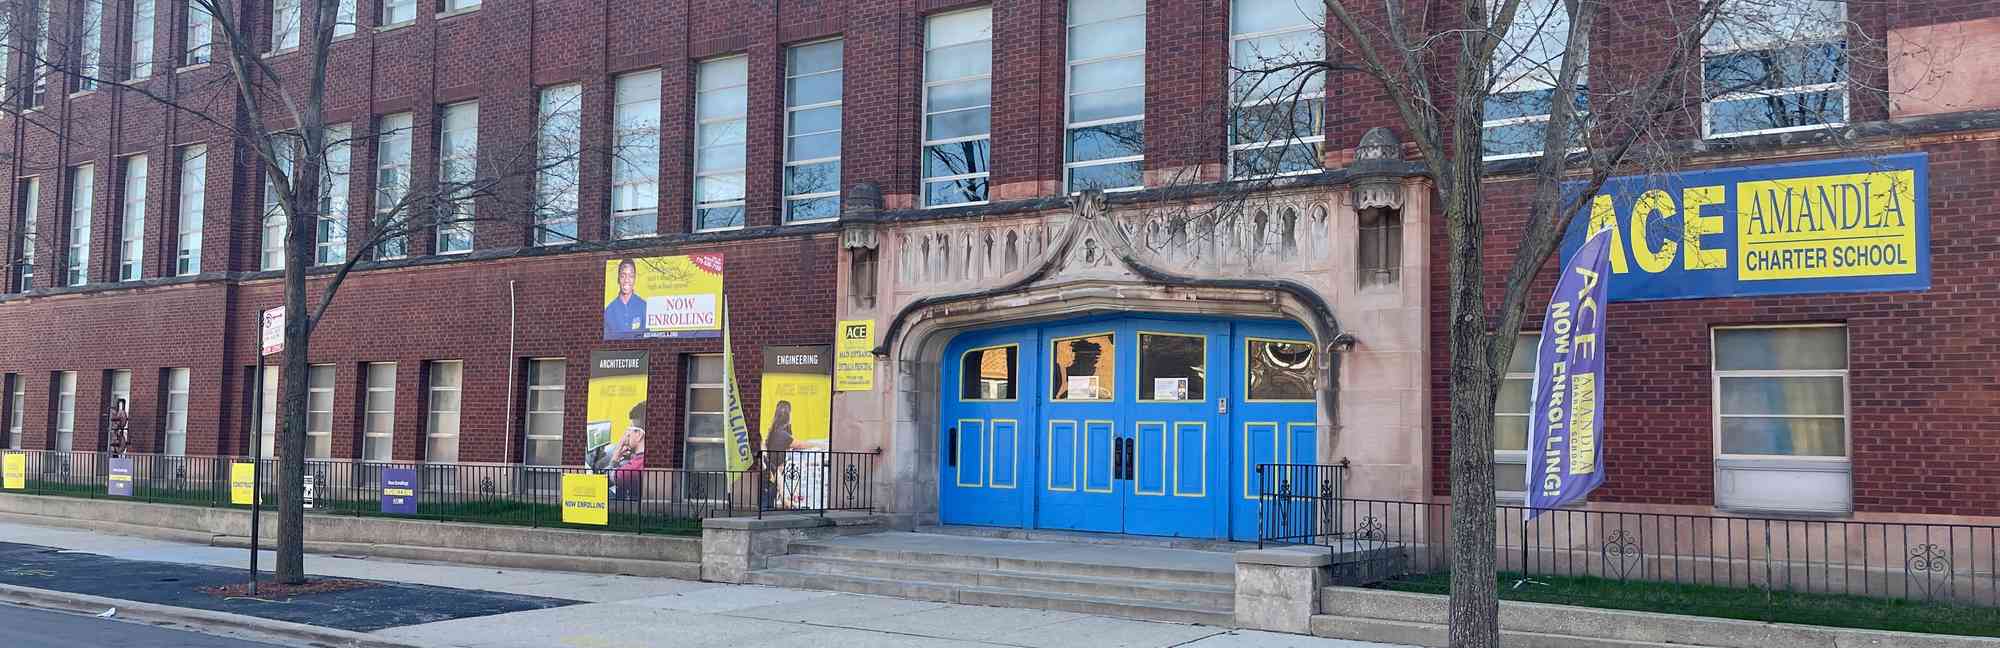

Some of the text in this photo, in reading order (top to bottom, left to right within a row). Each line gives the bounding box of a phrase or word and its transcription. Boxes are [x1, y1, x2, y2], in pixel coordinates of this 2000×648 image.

[1747, 180, 1905, 235] AMANDLA
[1586, 185, 1728, 274] ACE
[1746, 243, 1907, 271] CHARTER SCHOOL
[666, 297, 695, 311] NOW
[648, 311, 713, 326] ENROLLING
[1573, 267, 1599, 365] ACE
[847, 326, 866, 338] ACE
[599, 359, 640, 368] ARCHITECTURE
[777, 354, 818, 365] ENGINEERING
[1543, 301, 1571, 496] NOW ENROLLING!
